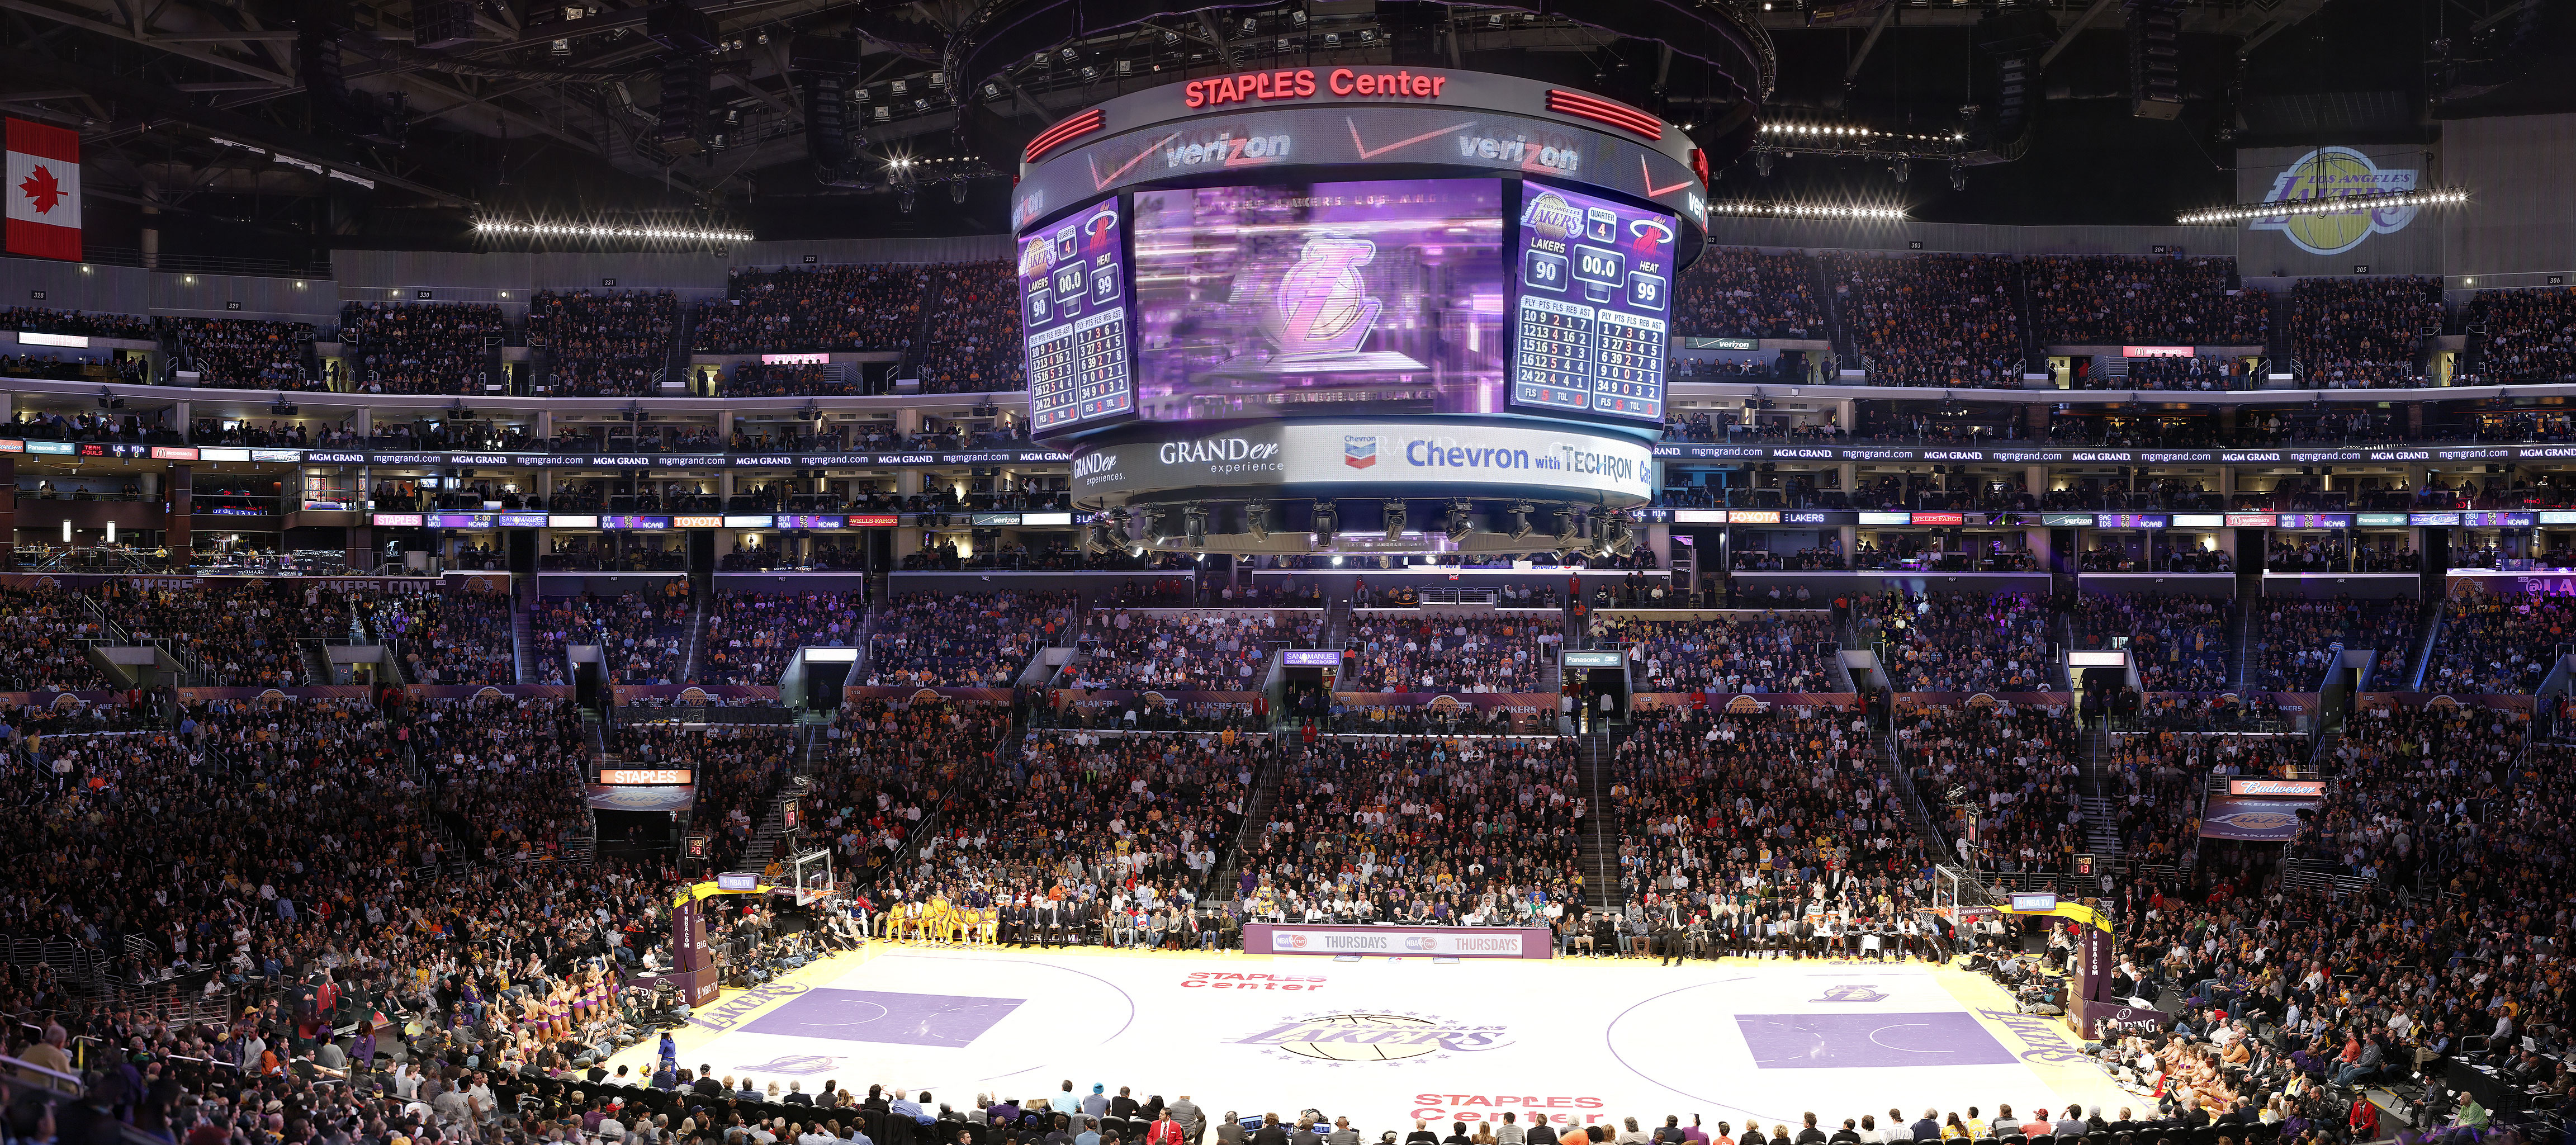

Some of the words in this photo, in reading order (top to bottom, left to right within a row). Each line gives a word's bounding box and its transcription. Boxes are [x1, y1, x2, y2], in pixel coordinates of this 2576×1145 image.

[1186, 69, 1315, 108] STAPLES
[1329, 68, 1445, 97] Center
[1167, 133, 1290, 168] verizon
[1459, 135, 1579, 175] verizon
[2308, 174, 2336, 183] LOS
[2338, 173, 2411, 183] ANGELES
[1553, 205, 1581, 216] ANGELES
[1590, 209, 1614, 222] QUARTER
[1527, 204, 1579, 234] LAKERS
[1058, 227, 1074, 240] QUARTER
[1598, 223, 1606, 236] 4
[1065, 240, 1071, 253] 4
[1531, 236, 1566, 253] LAKERS
[1097, 252, 1111, 267] HEAT
[1582, 255, 1615, 277] 00.0
[1535, 261, 1556, 281] 90
[1639, 261, 1659, 274] HEAT
[1028, 276, 1049, 293] LAKERS
[1059, 271, 1081, 294] 00.0
[1097, 275, 1112, 295] 99
[1637, 282, 1656, 301] 99
[1033, 299, 1046, 318] 90
[1525, 298, 1535, 307] PLY
[1566, 305, 1577, 314] REB
[1602, 311, 1612, 320] PLY
[1614, 314, 1625, 323] PTS
[1627, 316, 1637, 325] FLS
[1652, 321, 1661, 329] AST
[1719, 340, 1749, 349] verizon
[1525, 387, 1536, 398] FLS
[1542, 390, 1550, 400] 5
[1557, 392, 1568, 401] TOL
[1576, 394, 1582, 405] 0
[1600, 398, 1611, 407] FLS
[1616, 399, 1623, 410] 5
[1630, 401, 1640, 410] TOL
[1647, 404, 1653, 414] 1
[374, 454, 441, 463] mgmgrand.com
[1692, 447, 1763, 457] mgmgrand.com
[1993, 452, 2062, 461] mgmgrand.com
[2291, 452, 2360, 461] mgmgrand.com
[517, 456, 583, 465] mgmgrand.com
[802, 456, 868, 465] mgmgrand.com
[1407, 439, 1530, 469] Chevron
[1535, 456, 1561, 471] with
[1562, 445, 1632, 483] TECHRON
[1211, 461, 1285, 475] experience
[378, 516, 418, 525] STAPLES
[675, 517, 721, 527] TOYOTA
[1730, 512, 1779, 522] TOYOTA
[615, 770, 677, 784] STAPLES
[2241, 781, 2315, 794] Budweiser
[786, 802, 795, 812] 5:22
[2081, 865, 2089, 874] 13
[2026, 899, 2039, 907] NBA
[1325, 935, 1387, 949] THURSDAYS
[1455, 938, 1518, 950] THURSDAYS
[1188, 972, 1327, 982] STAPLES
[1181, 981, 1324, 991] Center
[1224, 1023, 1516, 1051] LAKERS
[1414, 1094, 1603, 1108] STAPLES
[1410, 1108, 1604, 1124] Center
